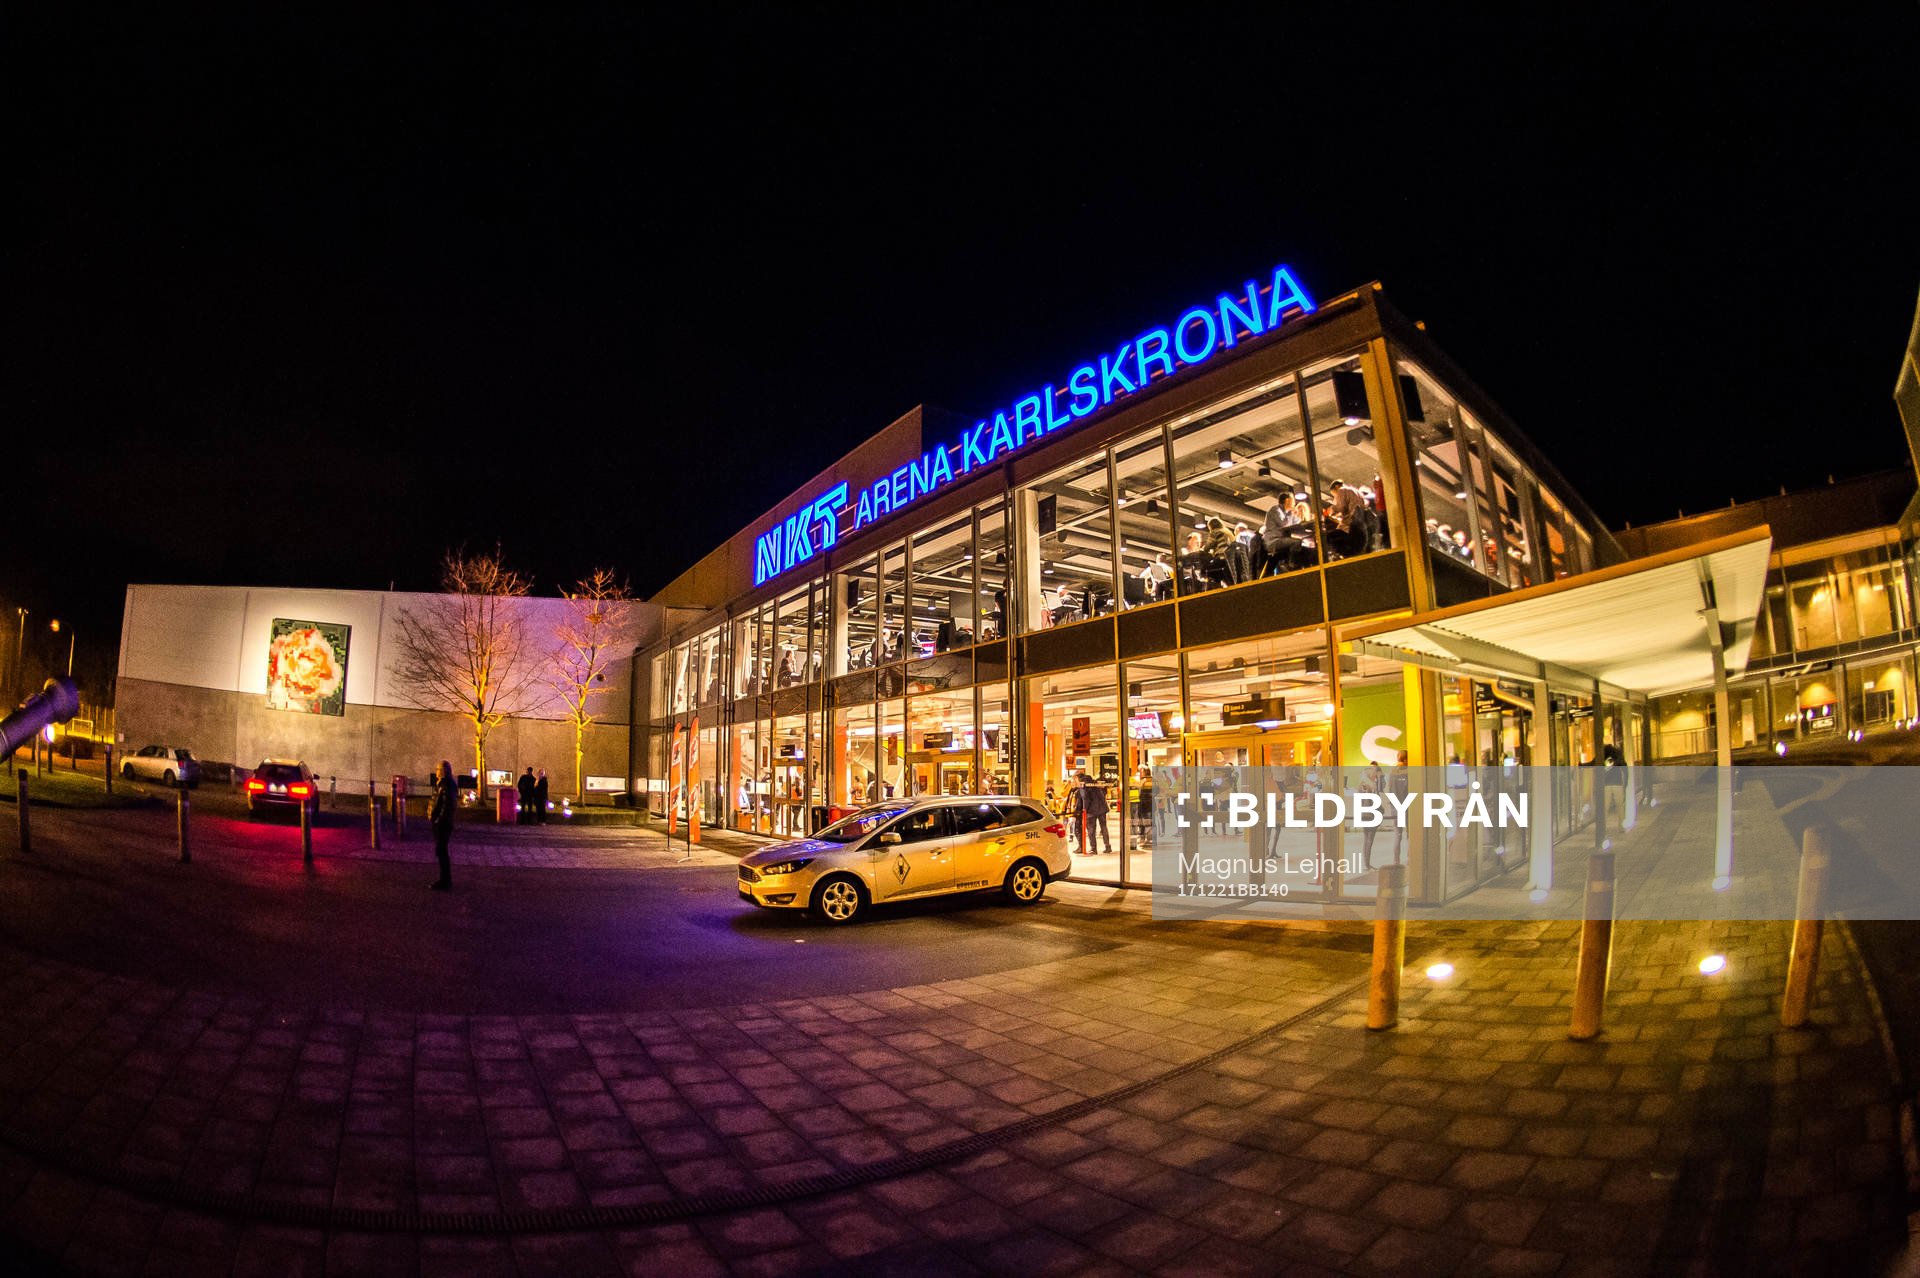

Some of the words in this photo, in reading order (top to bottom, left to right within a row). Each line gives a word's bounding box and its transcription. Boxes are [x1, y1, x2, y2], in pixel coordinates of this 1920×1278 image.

[755, 480, 849, 587] NKT
[855, 445, 953, 529] ARENA
[963, 267, 1315, 473] KARLSKRONA
[1025, 831, 1041, 840] SHL
